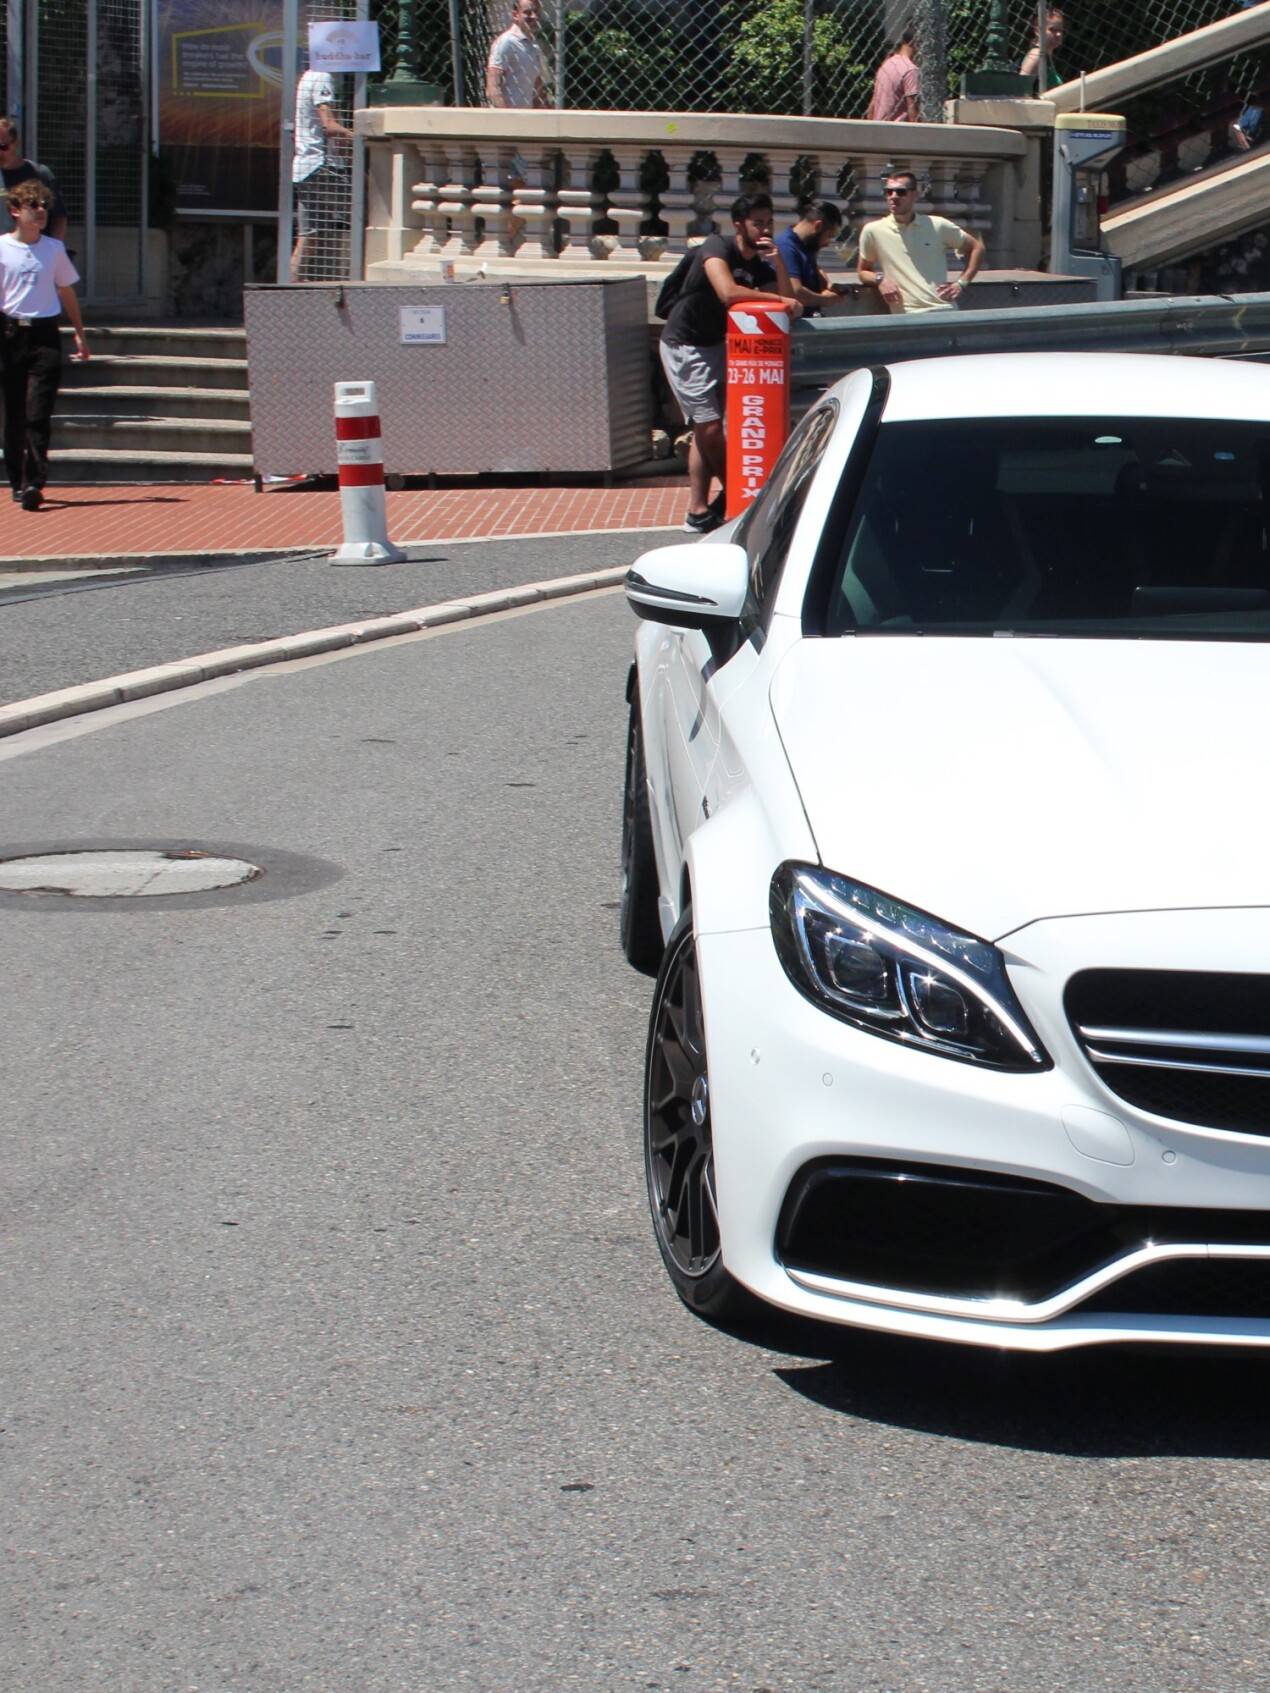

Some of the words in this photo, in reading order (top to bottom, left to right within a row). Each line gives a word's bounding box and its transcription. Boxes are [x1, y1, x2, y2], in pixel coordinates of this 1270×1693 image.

[734, 339, 752, 354] MAI
[754, 346, 783, 354] E-PRIX
[728, 368, 756, 384] 23-26
[760, 368, 784, 384] MAI
[741, 395, 766, 450] GRAND
[741, 455, 764, 498] PRIX
